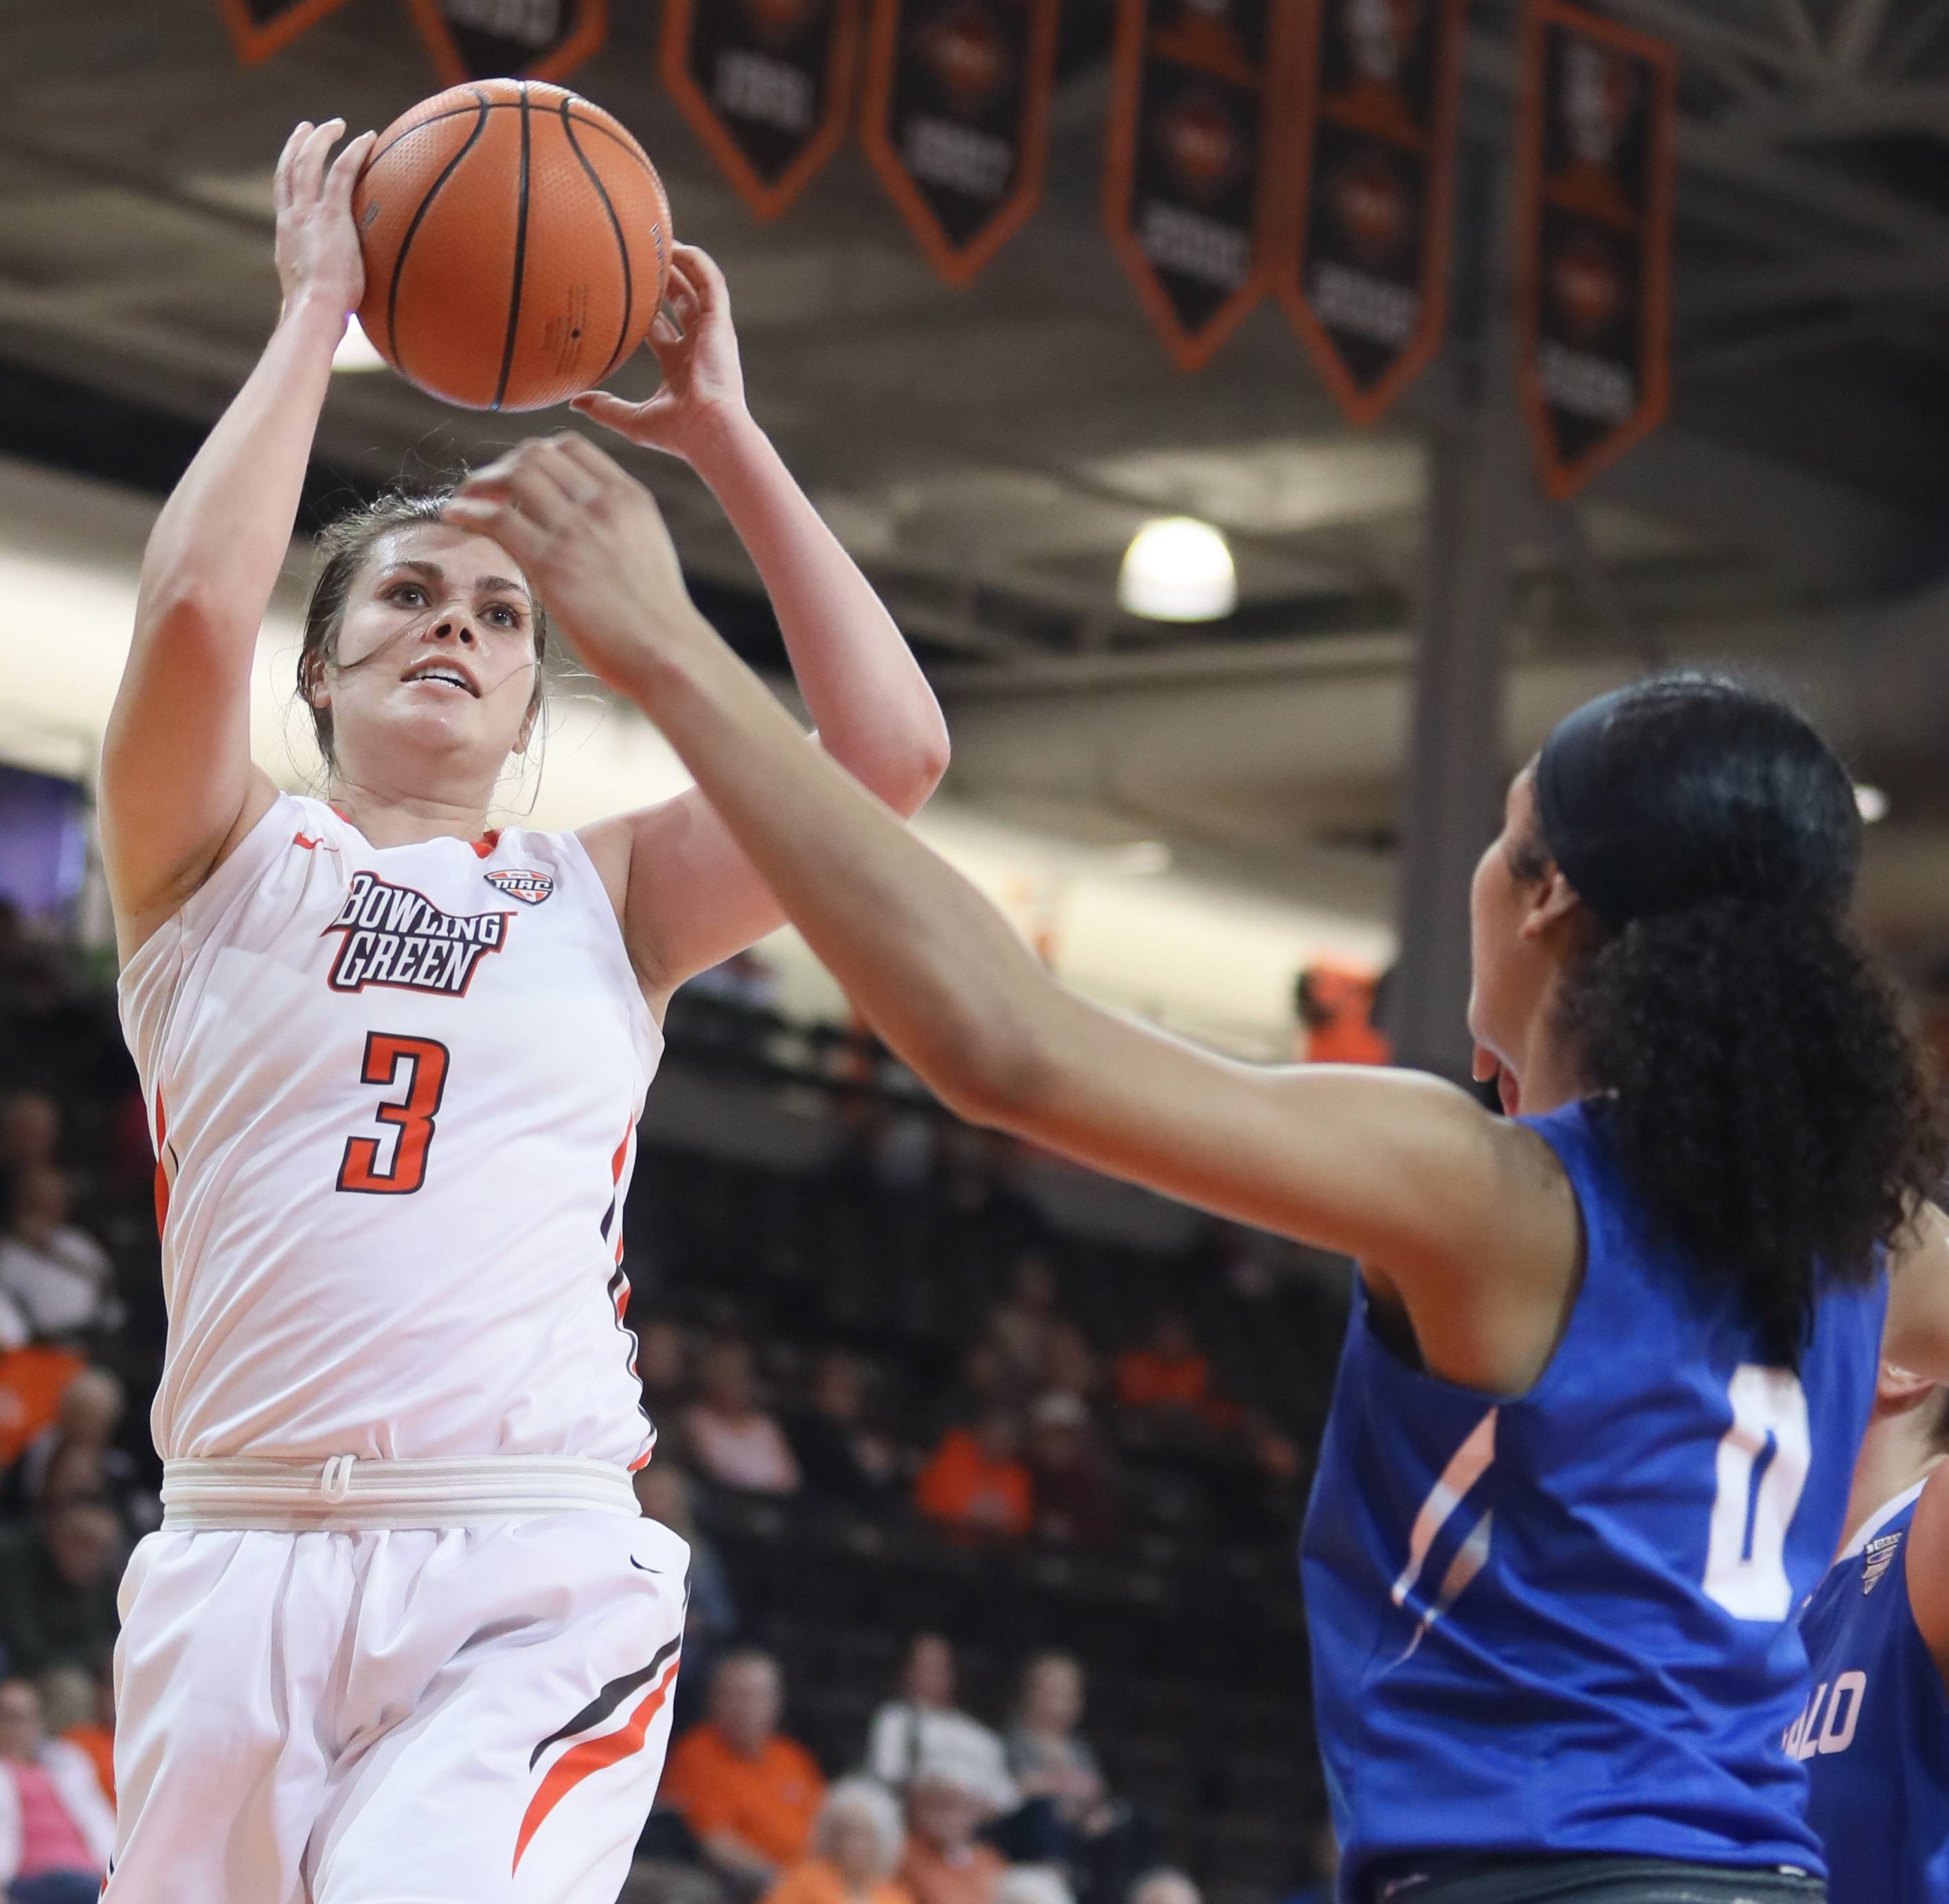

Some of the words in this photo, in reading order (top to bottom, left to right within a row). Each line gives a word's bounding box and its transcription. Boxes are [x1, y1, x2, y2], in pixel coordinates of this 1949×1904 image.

[334, 874, 500, 945] BOWLING
[495, 879, 552, 891] MAC
[336, 931, 480, 992] GREEN
[335, 1031, 450, 1194] 3
[1702, 1364, 1811, 1621] 0
